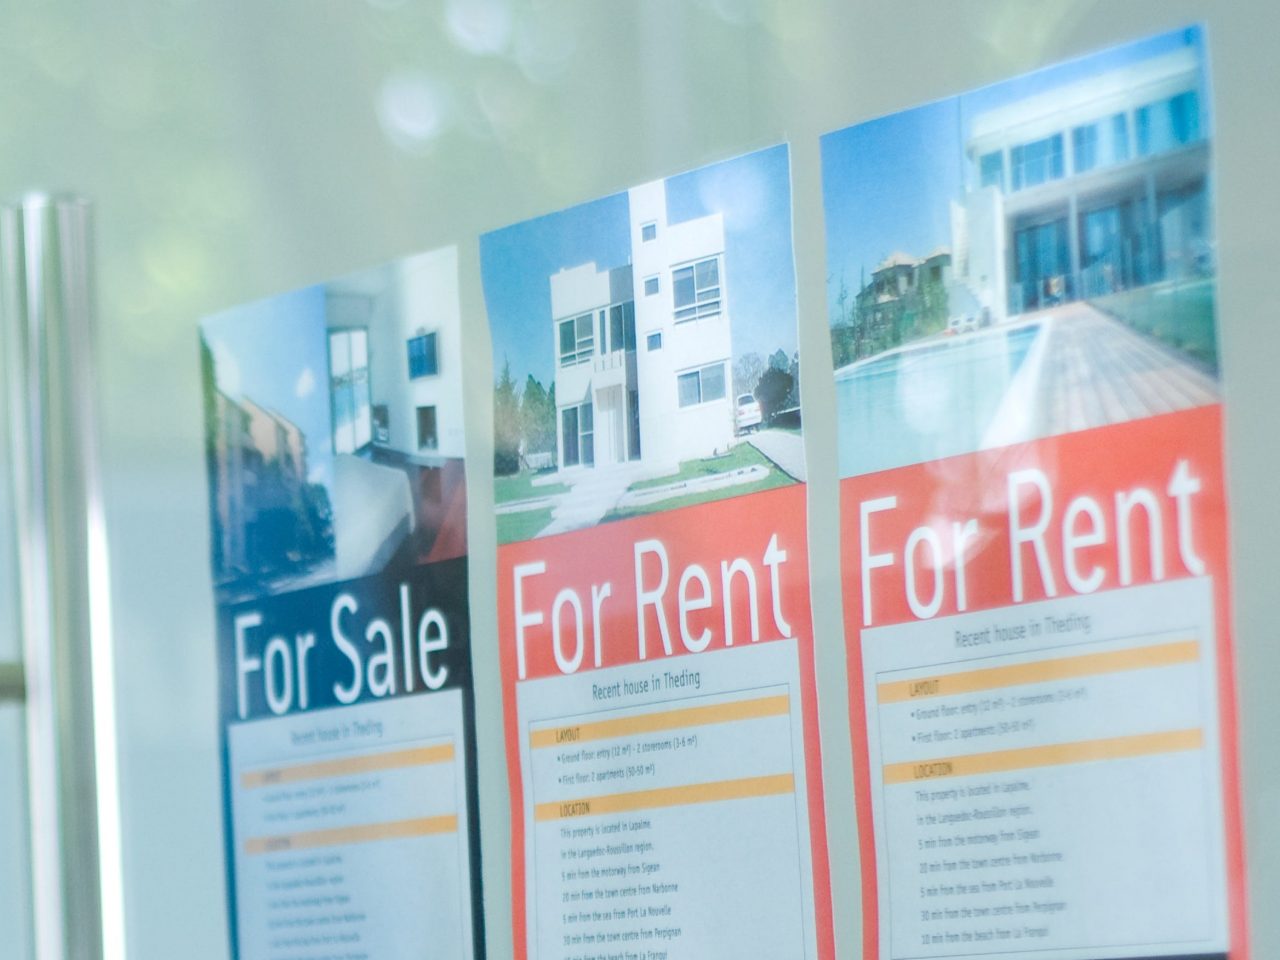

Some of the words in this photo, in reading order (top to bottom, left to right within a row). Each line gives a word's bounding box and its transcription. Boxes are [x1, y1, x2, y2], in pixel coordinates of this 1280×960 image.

[860, 496, 978, 627] For
[1007, 459, 1206, 603] Rent
[513, 561, 611, 680] For
[634, 533, 791, 660] Rent
[954, 628, 991, 648] Recent
[995, 623, 1025, 642] house
[1030, 619, 1041, 637] in
[1044, 612, 1091, 637] Theding
[234, 610, 316, 720] For
[330, 582, 449, 704] Sale
[593, 680, 621, 702] Recent
[624, 679, 648, 697] house
[652, 675, 661, 691] in
[664, 670, 700, 691] Theding
[556, 728, 580, 743] LAYOUT
[562, 750, 580, 764] Ground
[596, 749, 610, 760] entry
[612, 745, 620, 759] (12
[637, 744, 640, 753] 2
[642, 739, 672, 752] storerooms
[562, 774, 574, 784] First
[591, 772, 595, 782] 2
[596, 768, 624, 783] apartments
[560, 801, 590, 818] LOCATION
[560, 828, 571, 838] This
[572, 826, 594, 840] property
[602, 821, 620, 834] located
[622, 821, 628, 831] in
[652, 882, 678, 894] Narbonne
[648, 904, 672, 916] Nouvelle
